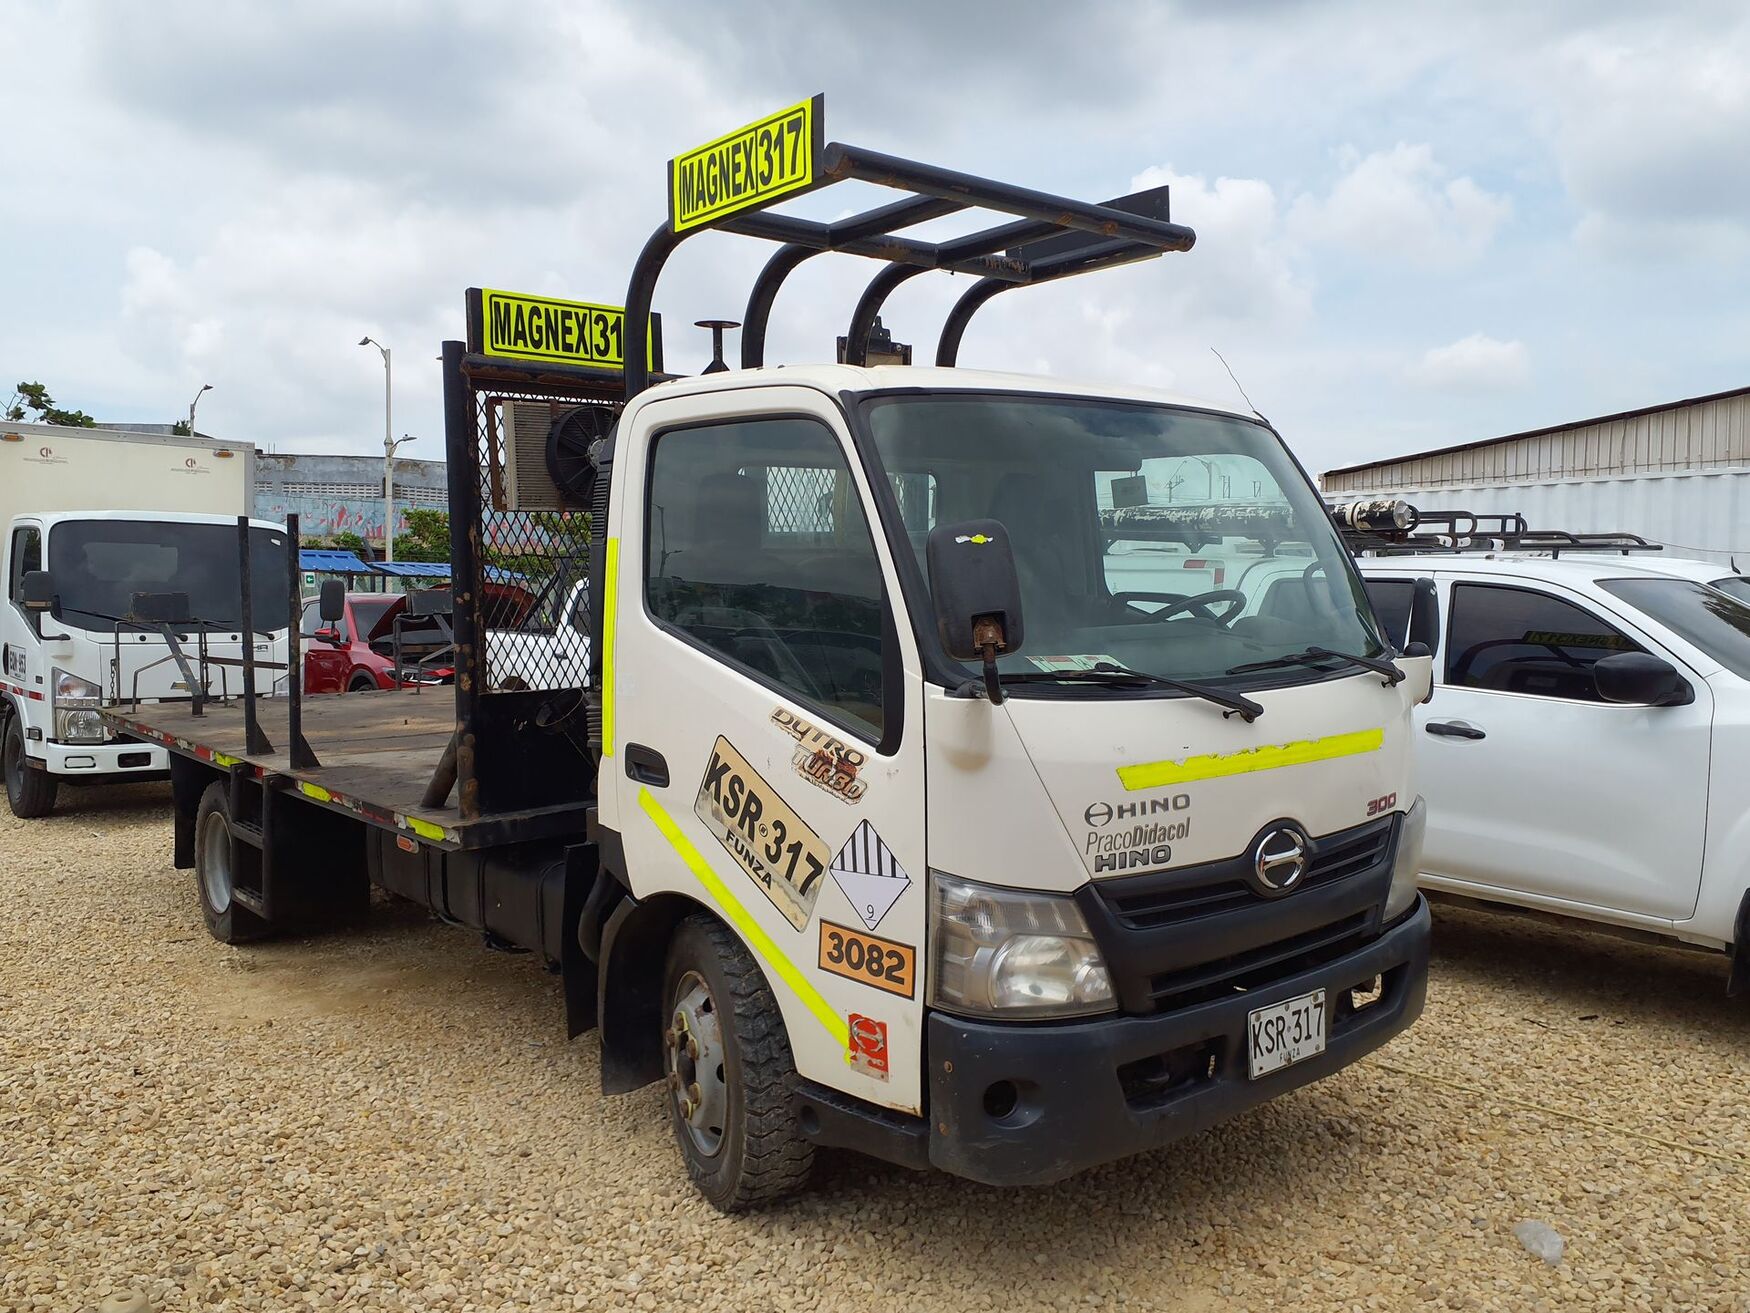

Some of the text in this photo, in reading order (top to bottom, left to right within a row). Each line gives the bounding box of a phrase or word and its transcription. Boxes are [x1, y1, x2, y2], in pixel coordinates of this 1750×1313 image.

[682, 115, 803, 216] MAGNEX 317
[493, 300, 623, 359] MAGNEX 31
[771, 708, 865, 767] DUTRO
[703, 752, 824, 897] KSR 317
[1117, 794, 1191, 819] HINO
[1366, 791, 1397, 817] 300
[725, 827, 773, 890] FUNZA
[1085, 817, 1191, 855] PracoDidacol
[1094, 844, 1172, 872] HINO
[866, 904, 875, 919] 9
[826, 931, 906, 986] 3082
[1252, 1002, 1324, 1060] KSR 317
